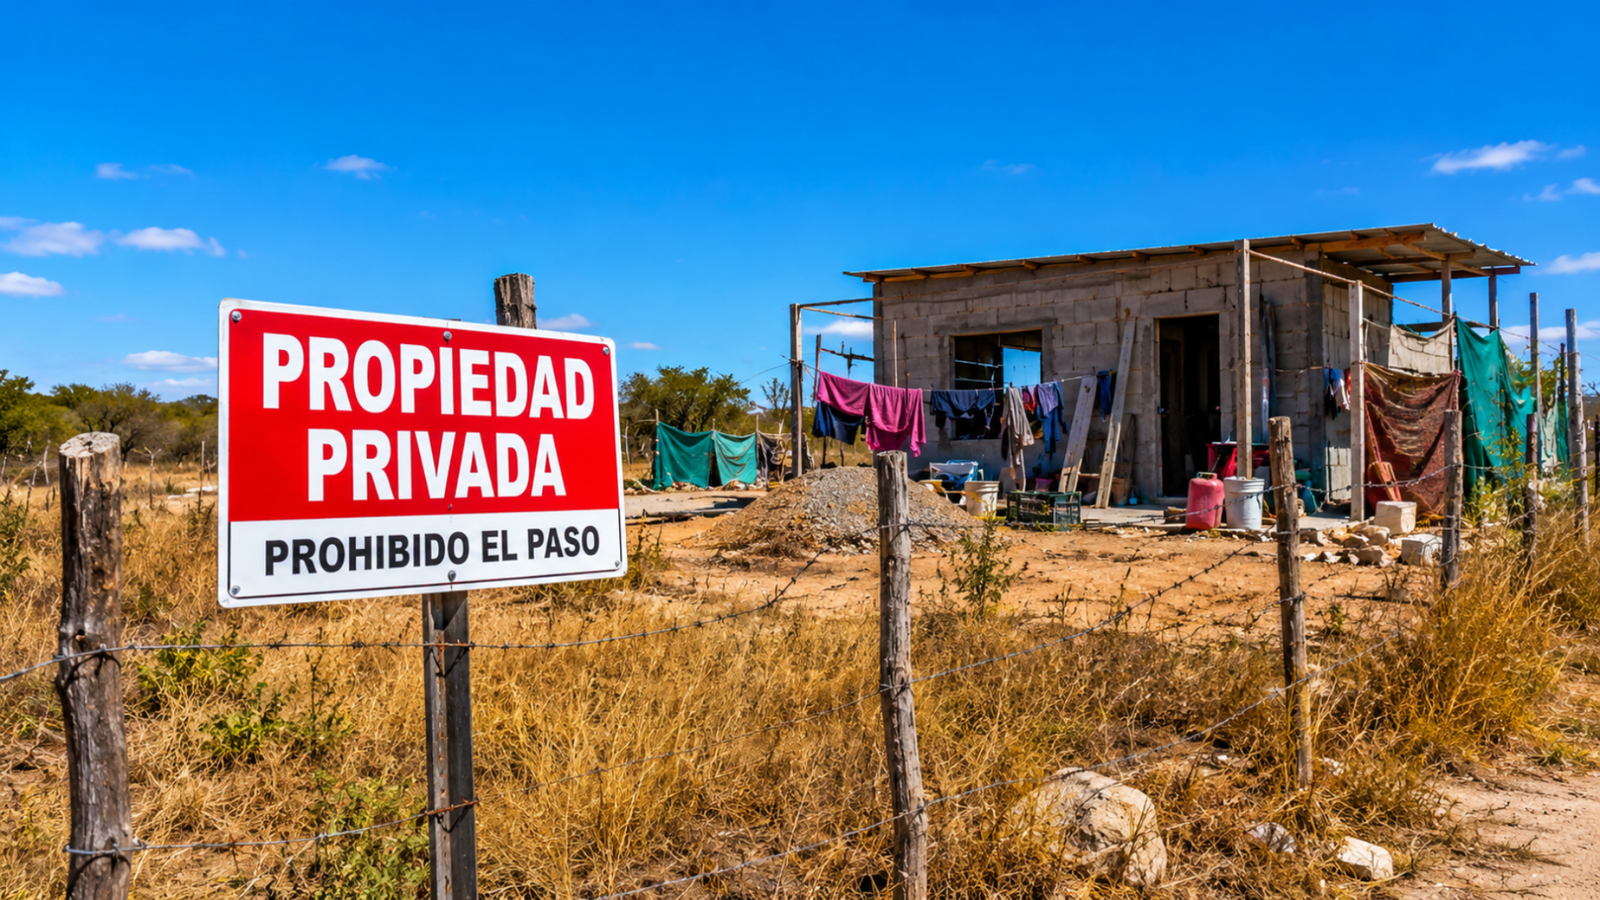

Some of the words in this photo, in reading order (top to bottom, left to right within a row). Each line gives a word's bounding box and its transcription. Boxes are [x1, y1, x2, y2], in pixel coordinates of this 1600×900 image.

[262, 332, 595, 420] PROPIEDAD
[307, 428, 567, 502] PRIVADA
[265, 531, 470, 576] PROHIBIDO
[481, 529, 518, 563] EL
[527, 525, 600, 560] PASO
